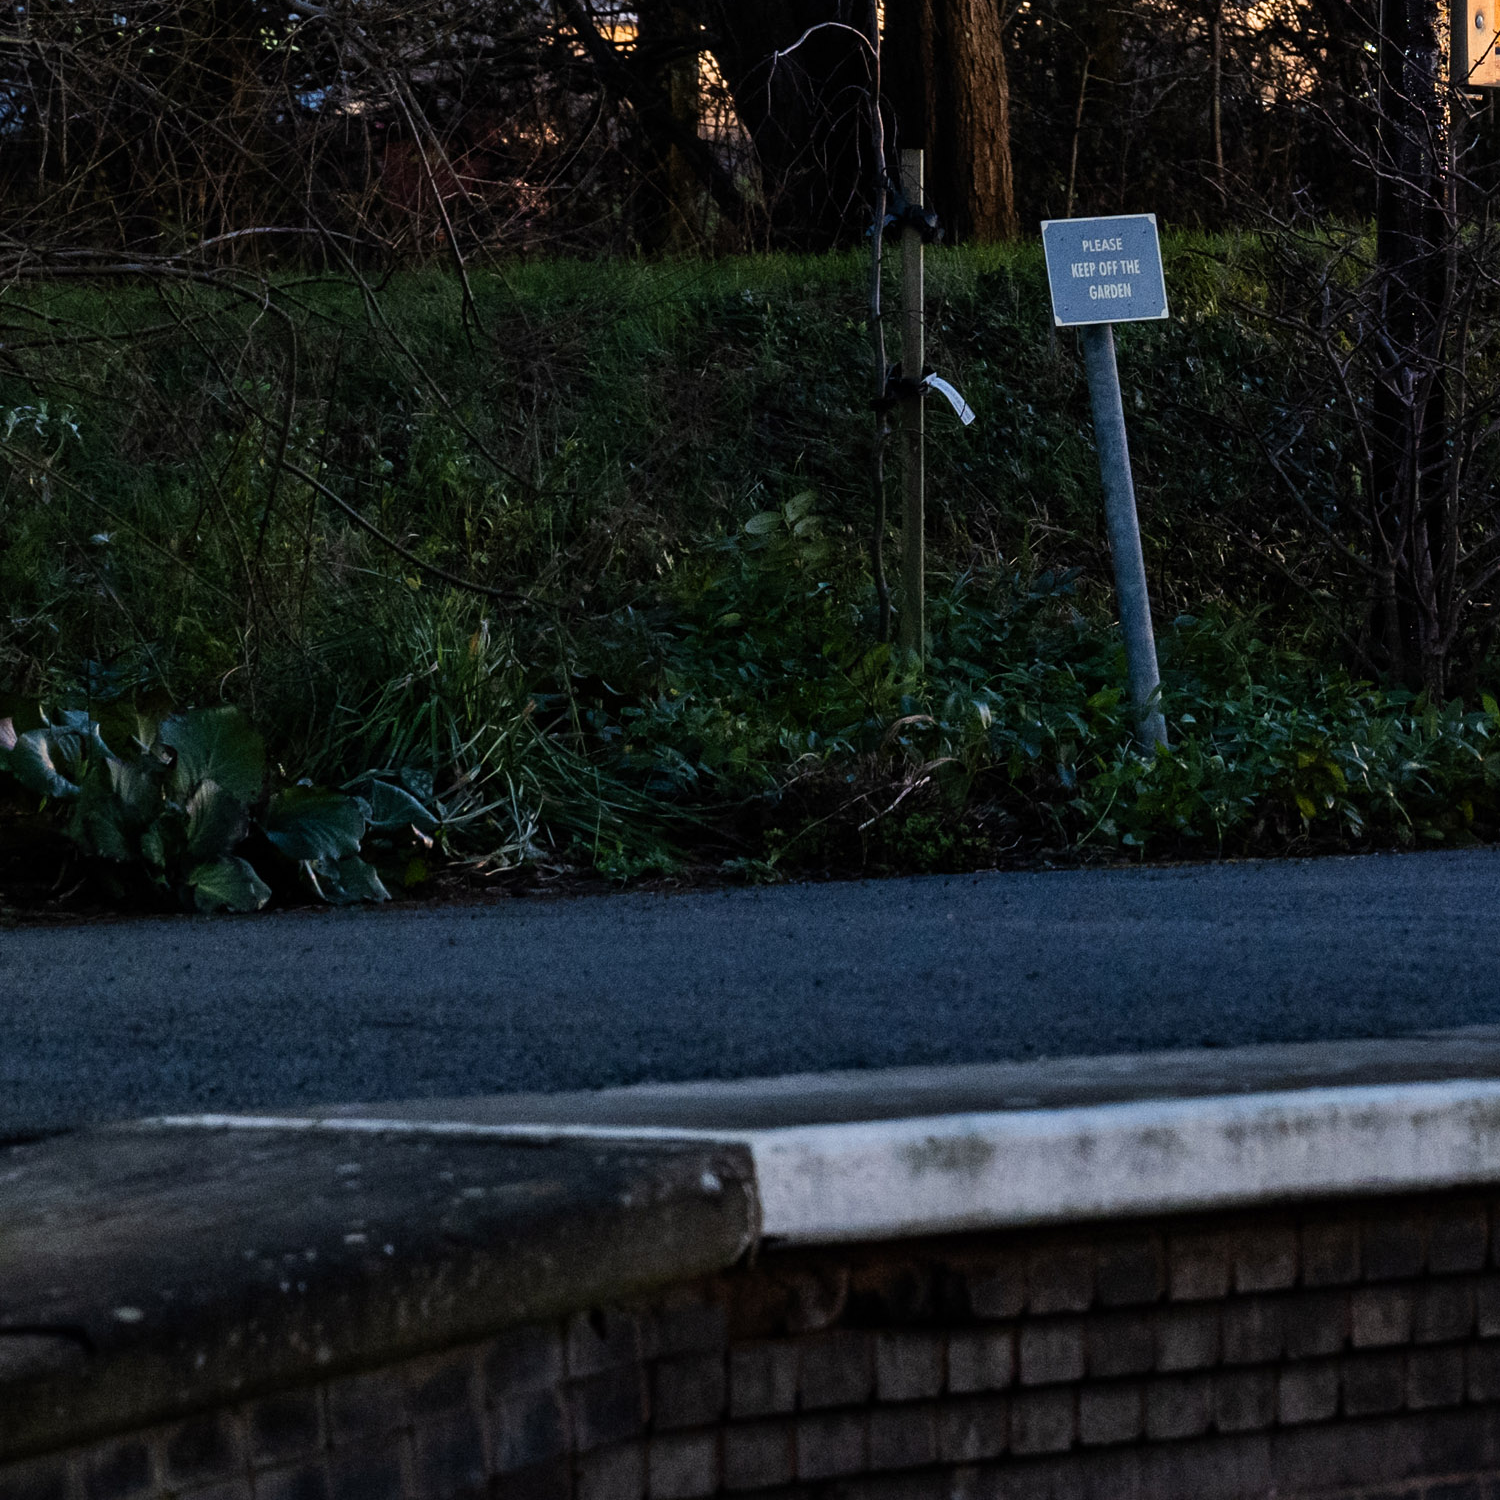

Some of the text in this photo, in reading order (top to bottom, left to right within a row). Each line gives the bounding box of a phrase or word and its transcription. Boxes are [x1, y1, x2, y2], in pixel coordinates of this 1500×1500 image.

[1082, 238, 1123, 252] PLEASE
[1071, 260, 1141, 278] KEEP OFF THE
[1089, 283, 1132, 300] GARDEN
